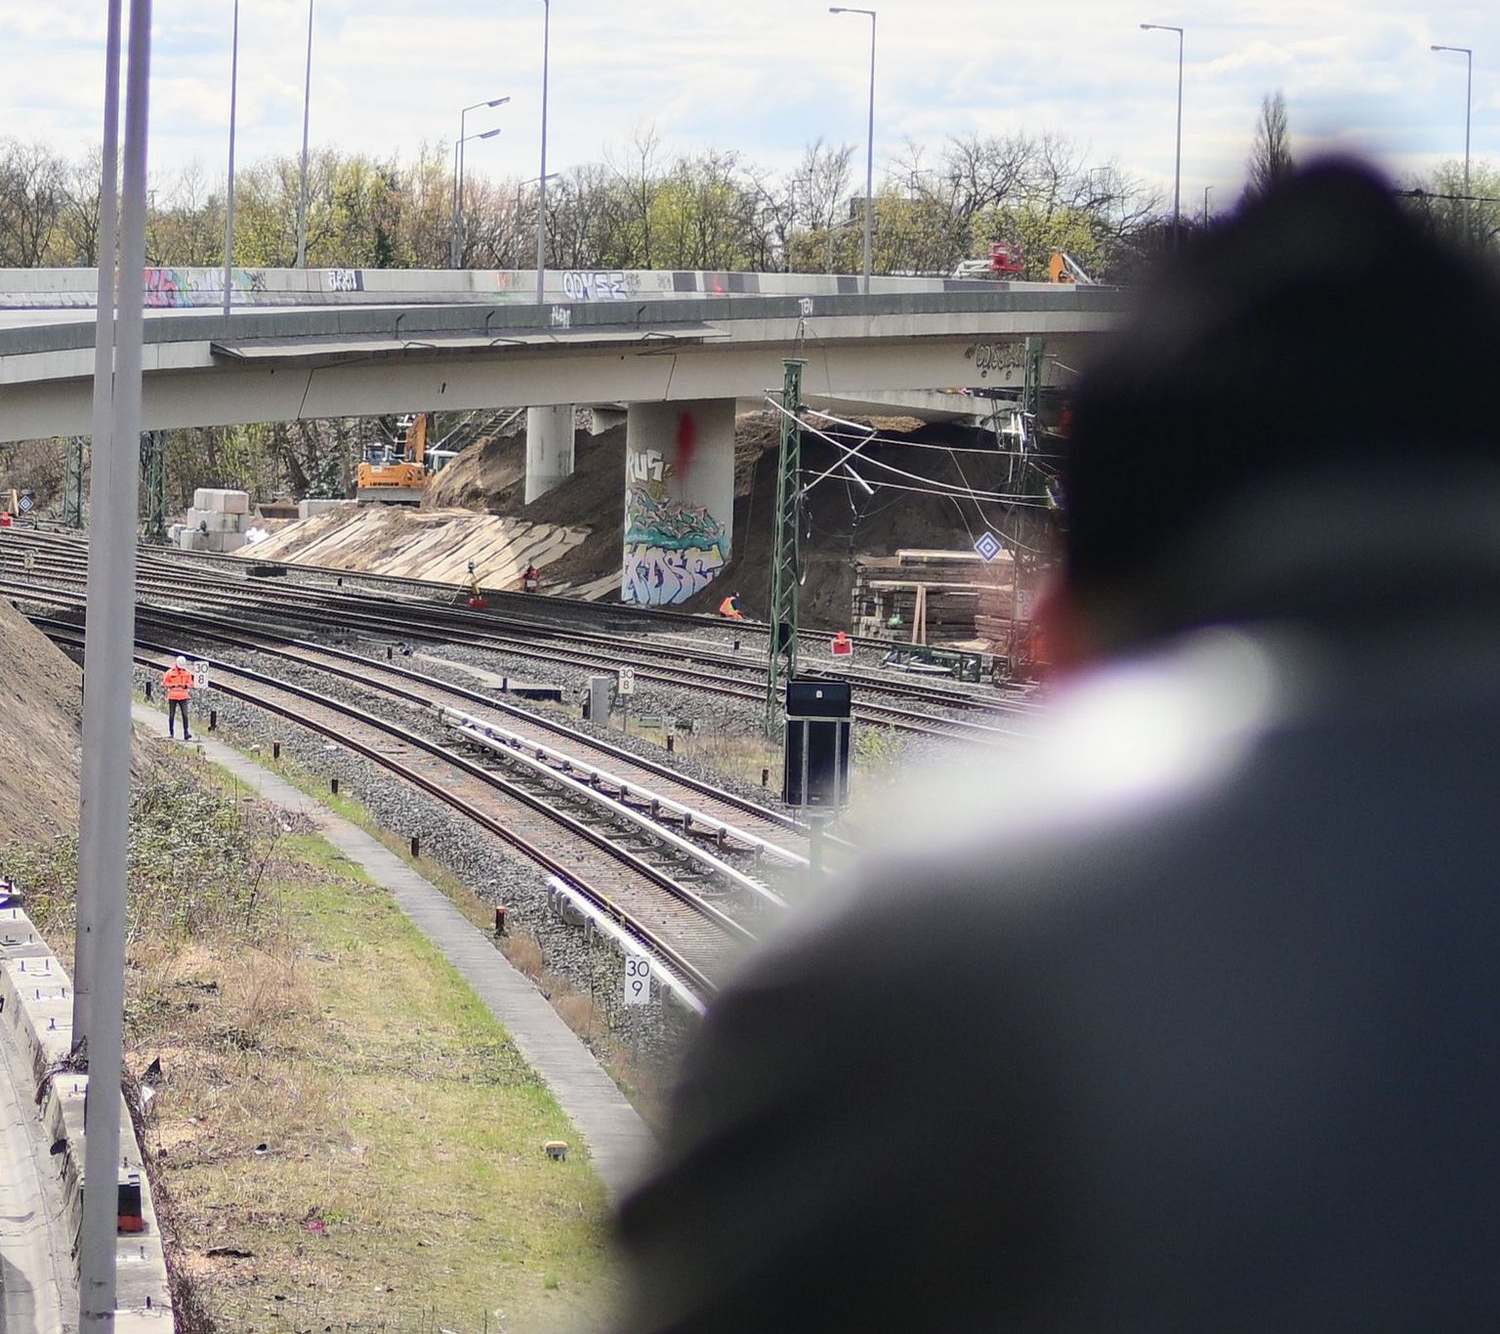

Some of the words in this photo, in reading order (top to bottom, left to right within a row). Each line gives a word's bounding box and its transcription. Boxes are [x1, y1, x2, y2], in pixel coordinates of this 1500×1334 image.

[195, 663, 209, 673] 30
[620, 668, 633, 679] 30
[198, 674, 205, 684] 8
[623, 680, 630, 690] 8
[627, 960, 650, 978] 30
[632, 980, 643, 997] 9
